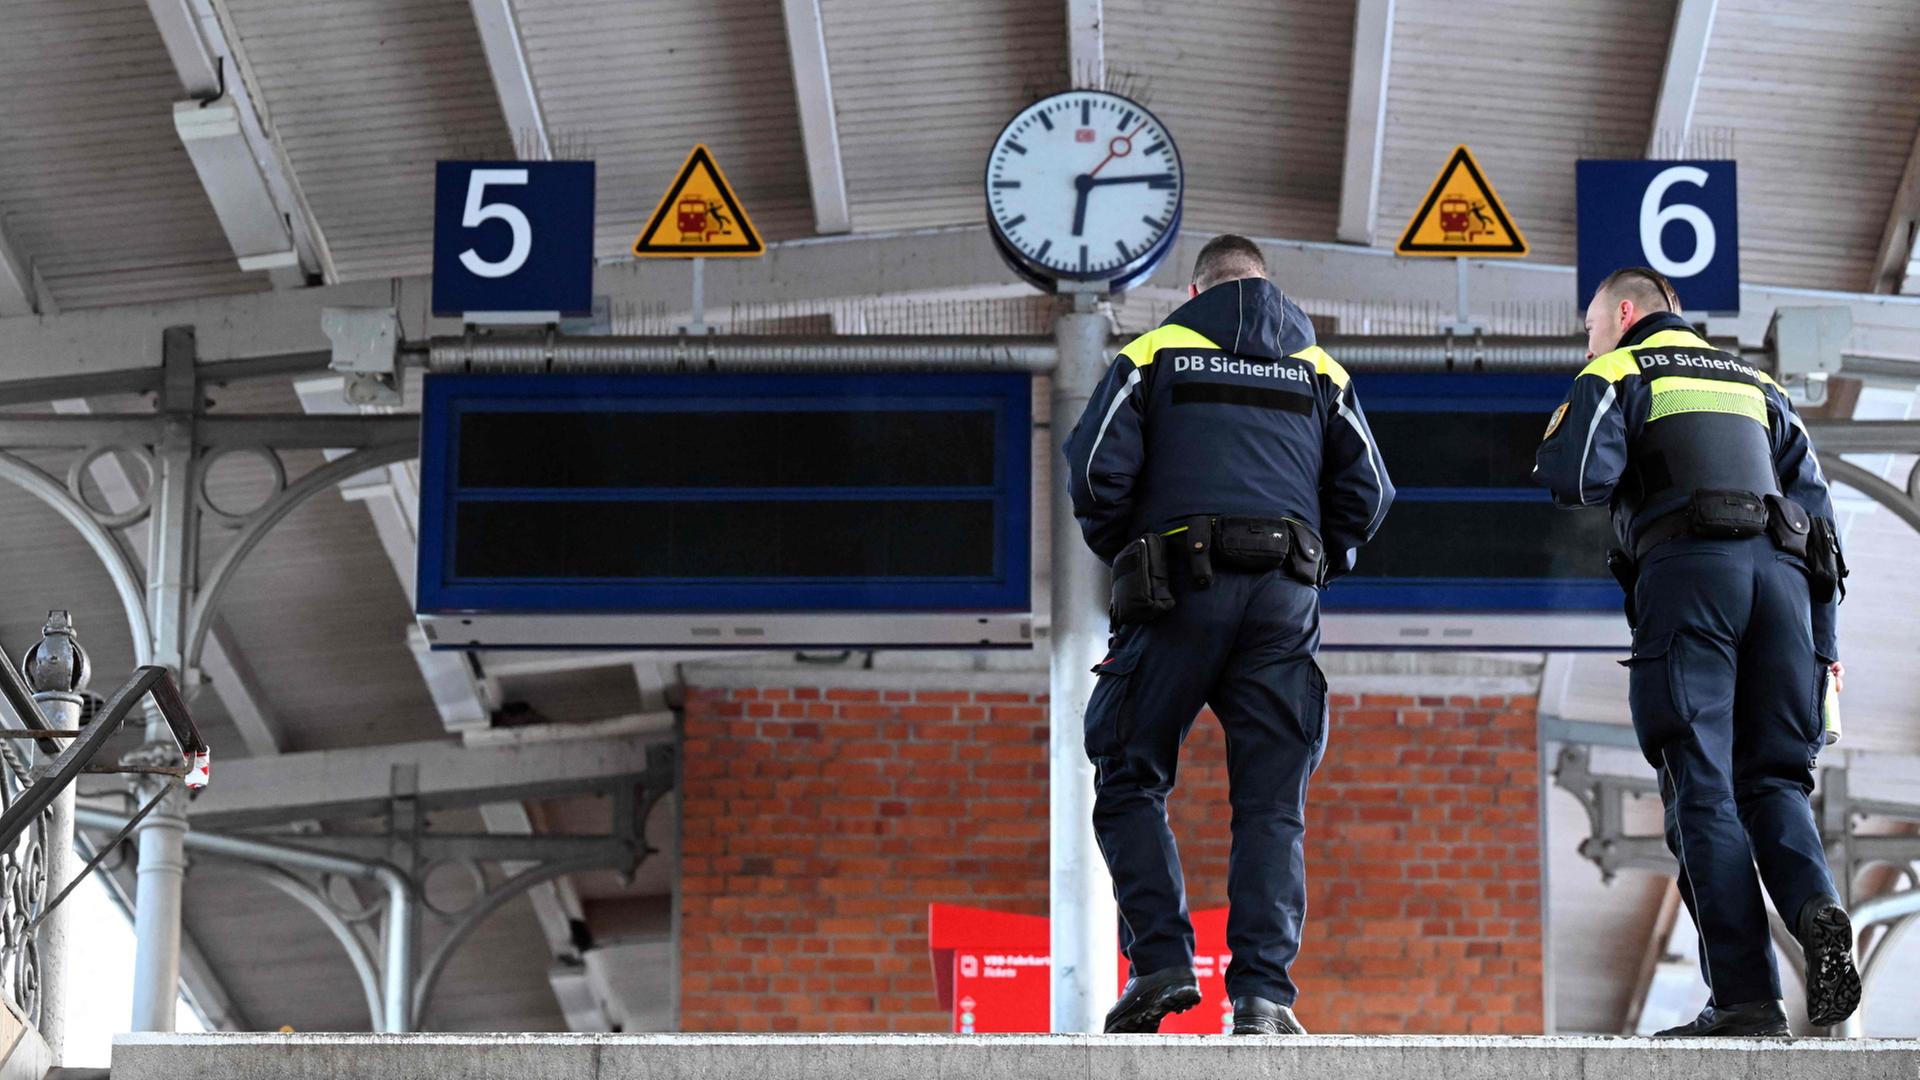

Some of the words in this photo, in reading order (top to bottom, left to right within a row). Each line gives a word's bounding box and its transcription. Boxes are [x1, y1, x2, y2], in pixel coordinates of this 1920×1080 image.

[458, 169, 532, 278] 5
[1639, 165, 1716, 278] 6
[1174, 355, 1205, 372] DB
[1210, 357, 1311, 384] Sicherheit
[1639, 354, 1670, 369] DB
